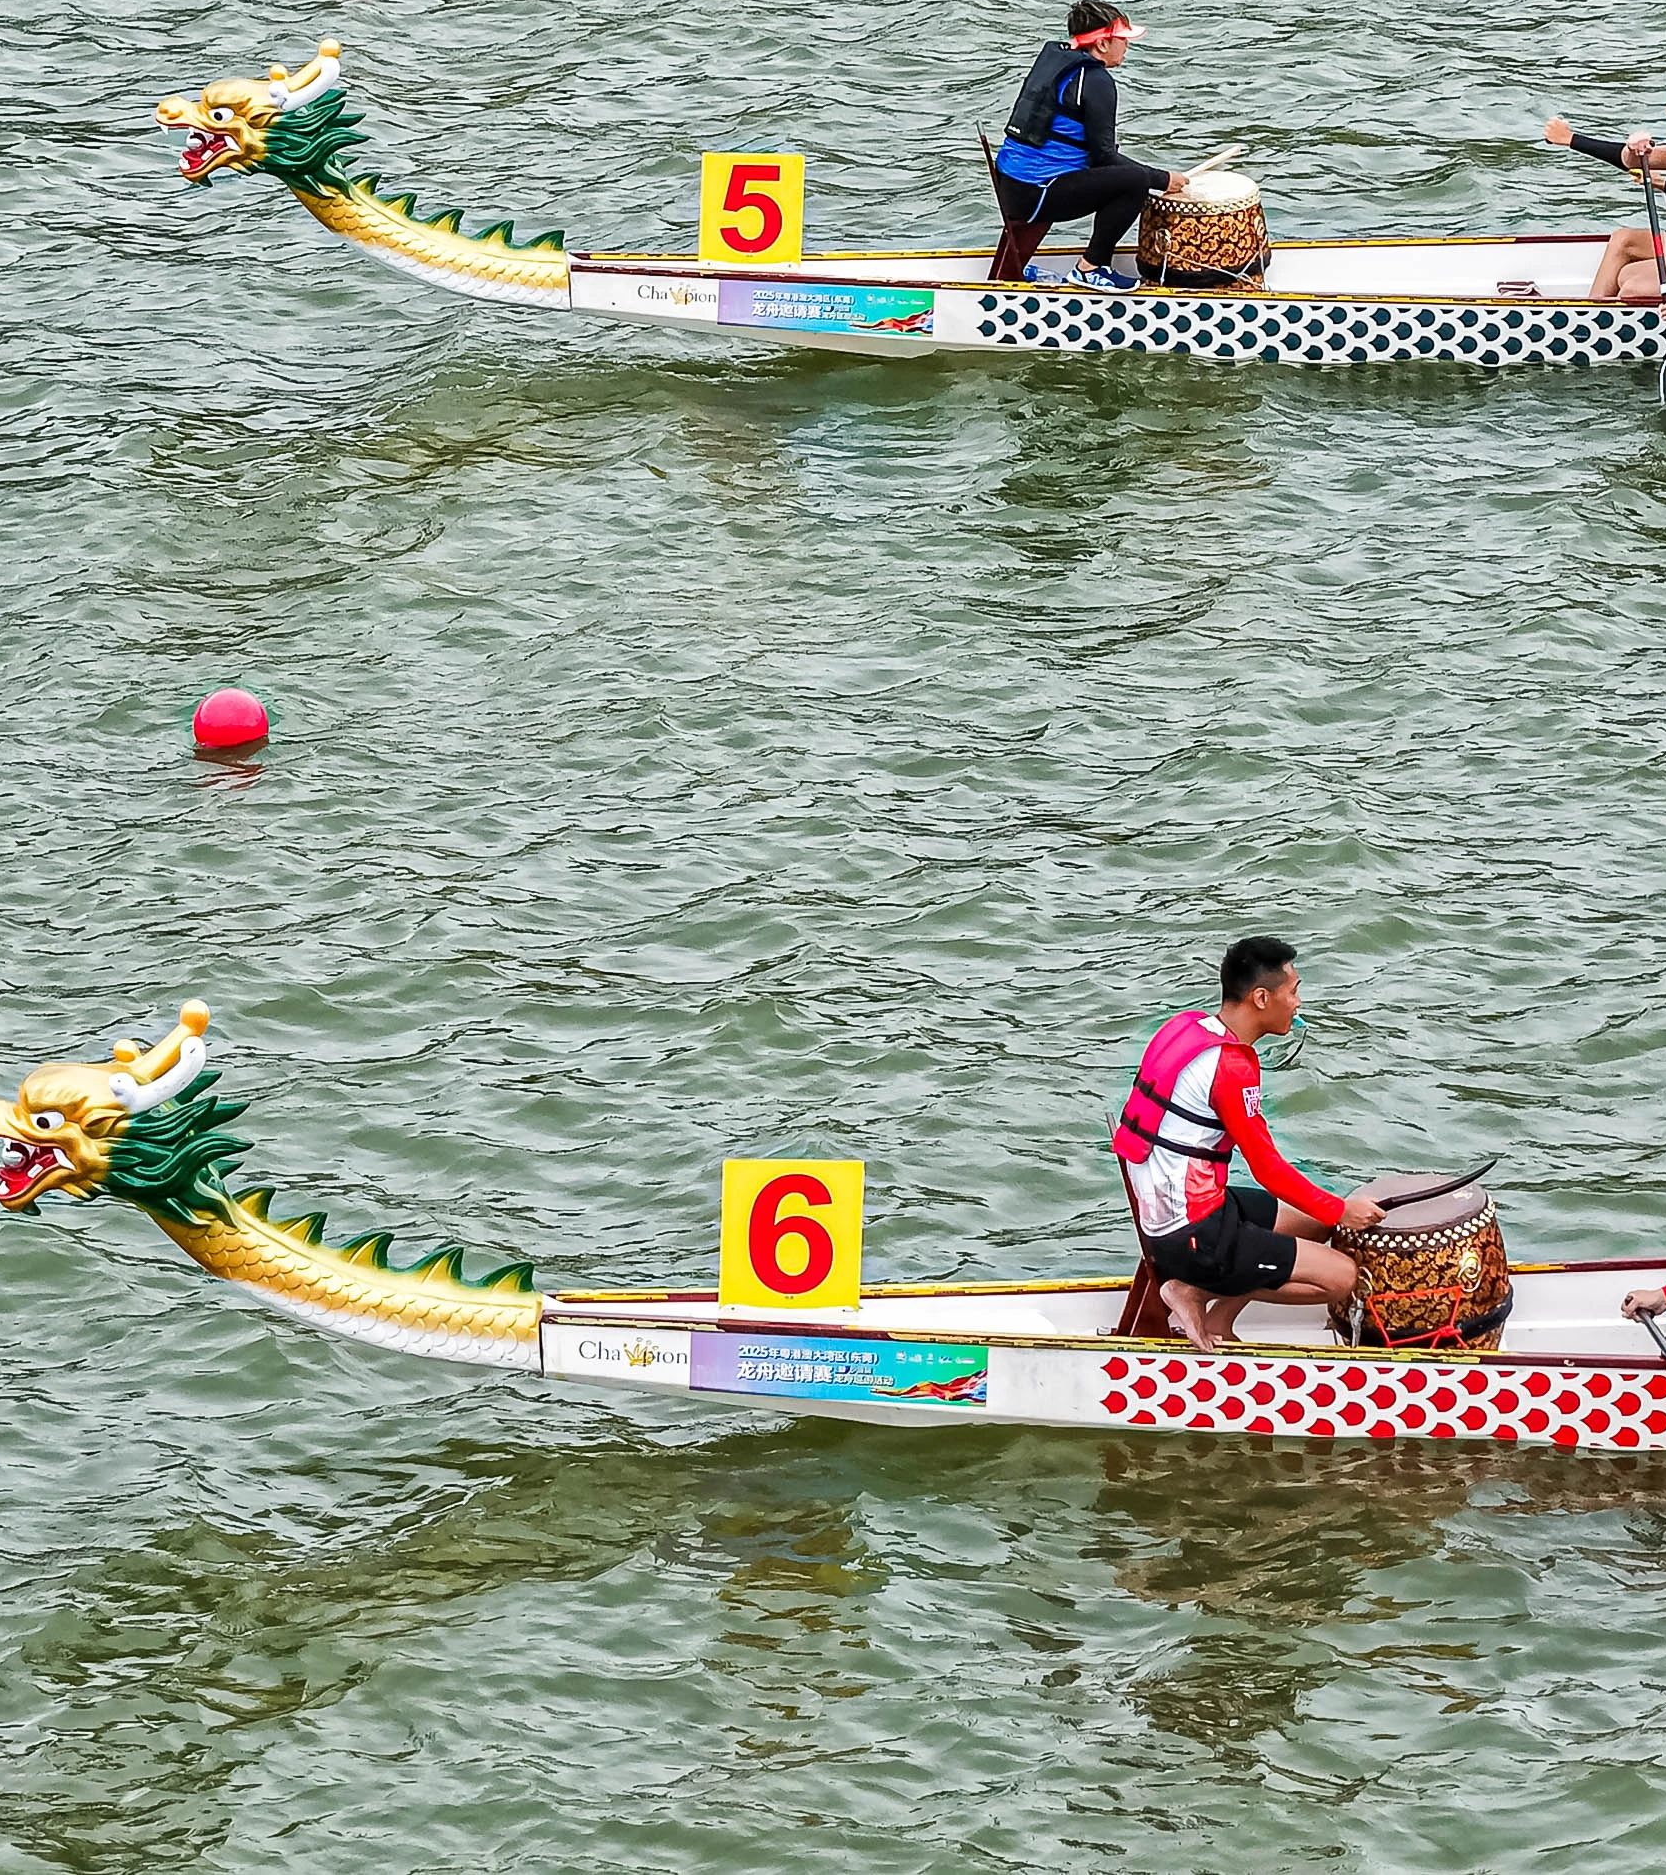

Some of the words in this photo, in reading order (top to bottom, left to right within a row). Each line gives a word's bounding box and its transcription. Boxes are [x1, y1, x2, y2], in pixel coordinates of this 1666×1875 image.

[719, 164, 783, 254] 5
[748, 1173, 834, 1295] 6
[736, 1359, 835, 1385] 龙舟邀请赛
